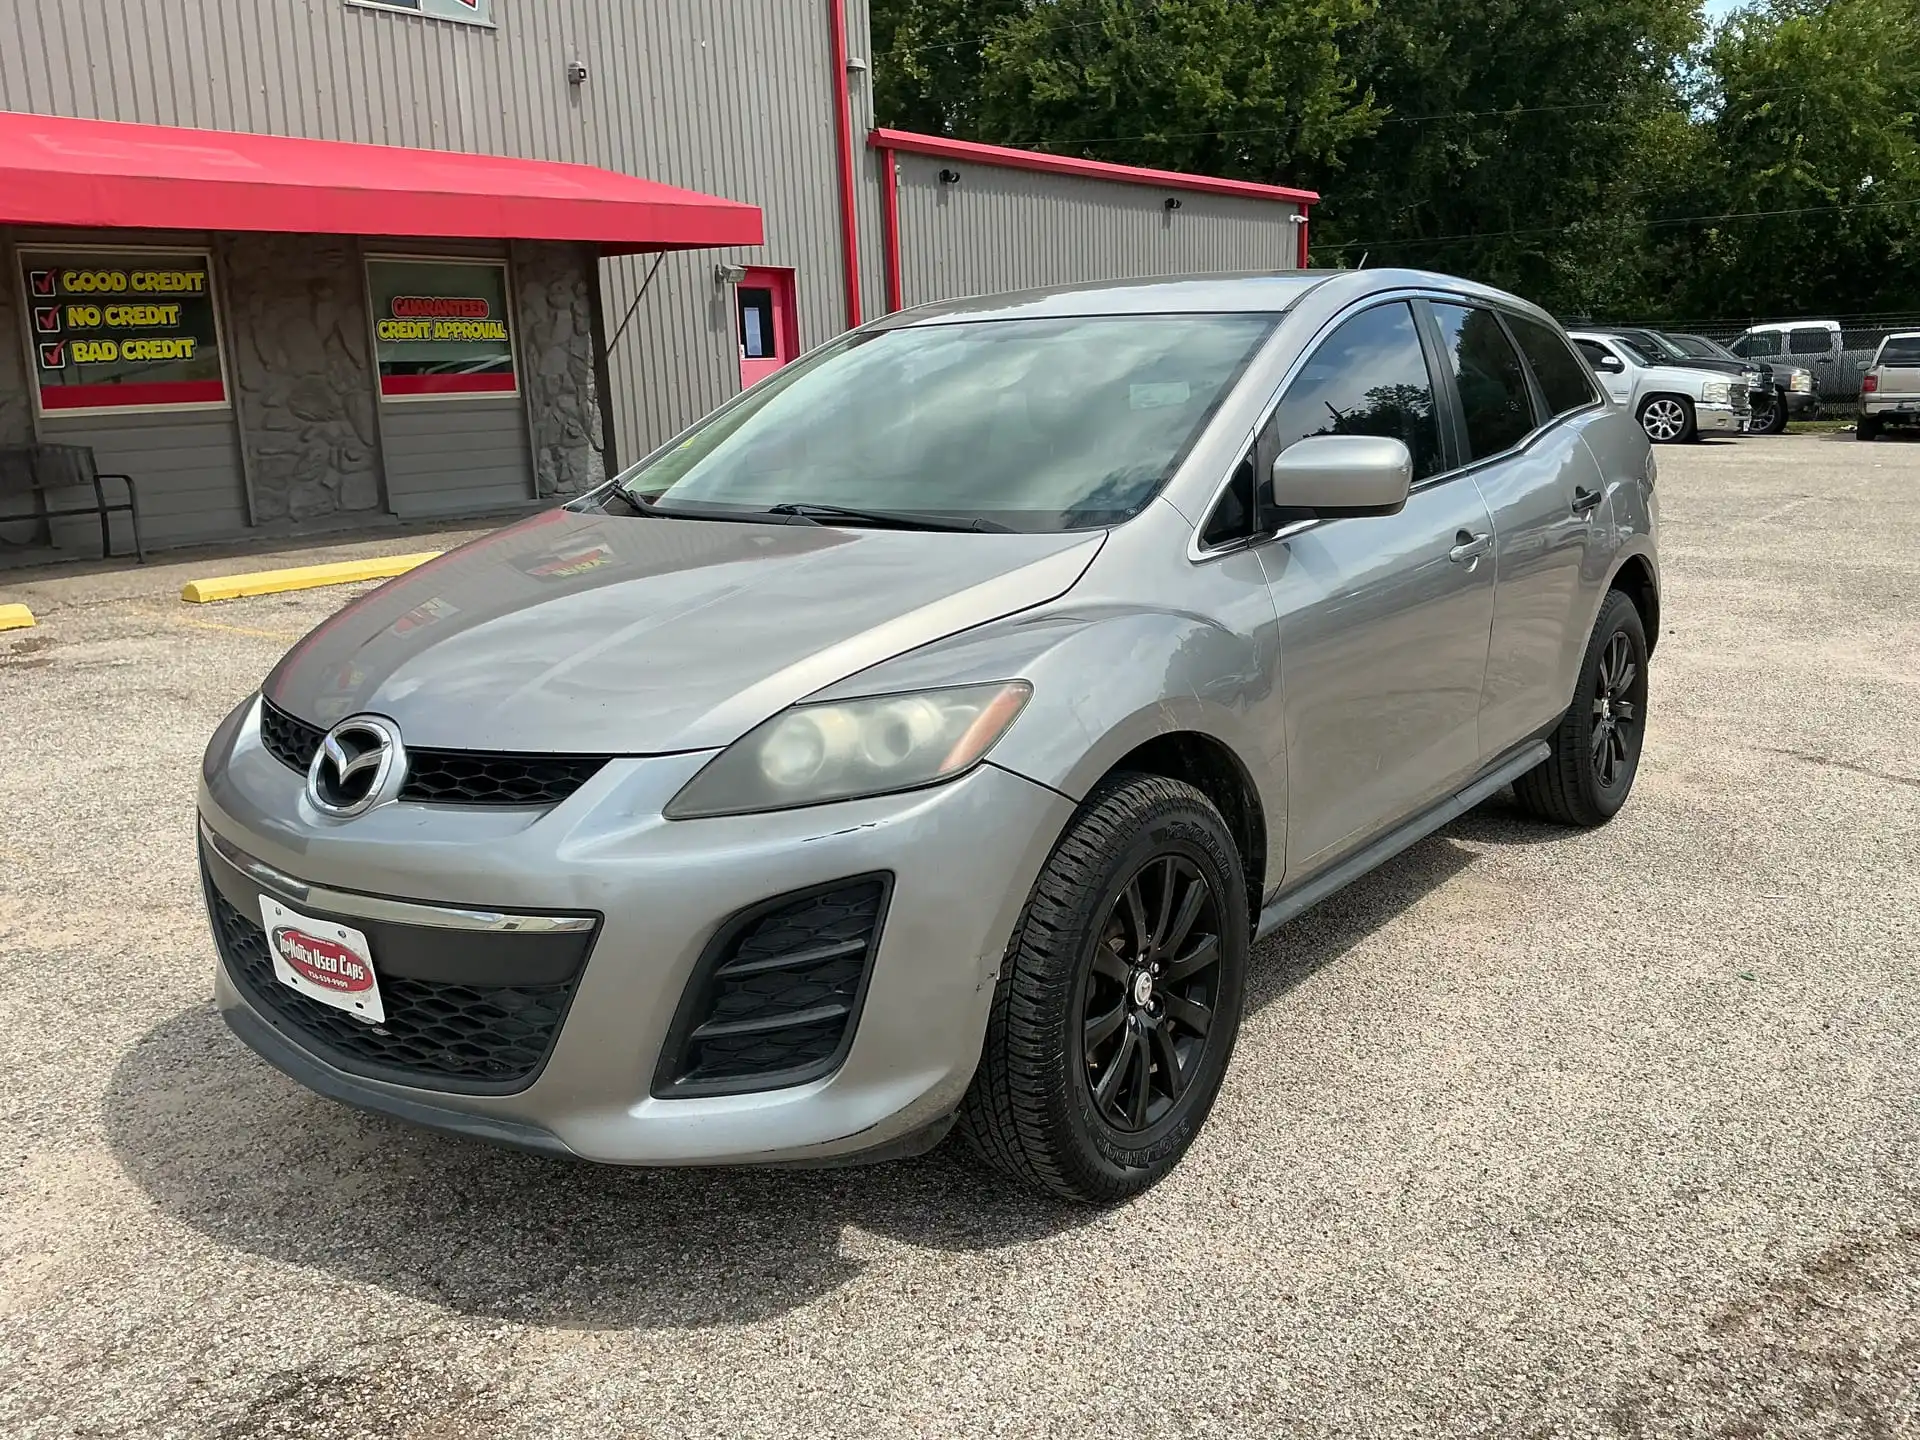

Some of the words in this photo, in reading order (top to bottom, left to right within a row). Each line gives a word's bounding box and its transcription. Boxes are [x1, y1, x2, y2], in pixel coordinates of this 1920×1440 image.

[63, 271, 128, 292] GOOD
[130, 271, 205, 292] CREDIT
[67, 306, 101, 327] NO
[104, 305, 179, 326] CREDIT
[393, 298, 487, 317] GUARANTEED
[378, 321, 431, 339] CREDIT
[434, 321, 506, 339] APPROVAL
[71, 341, 118, 363] BAD
[121, 339, 195, 361] CREDIT
